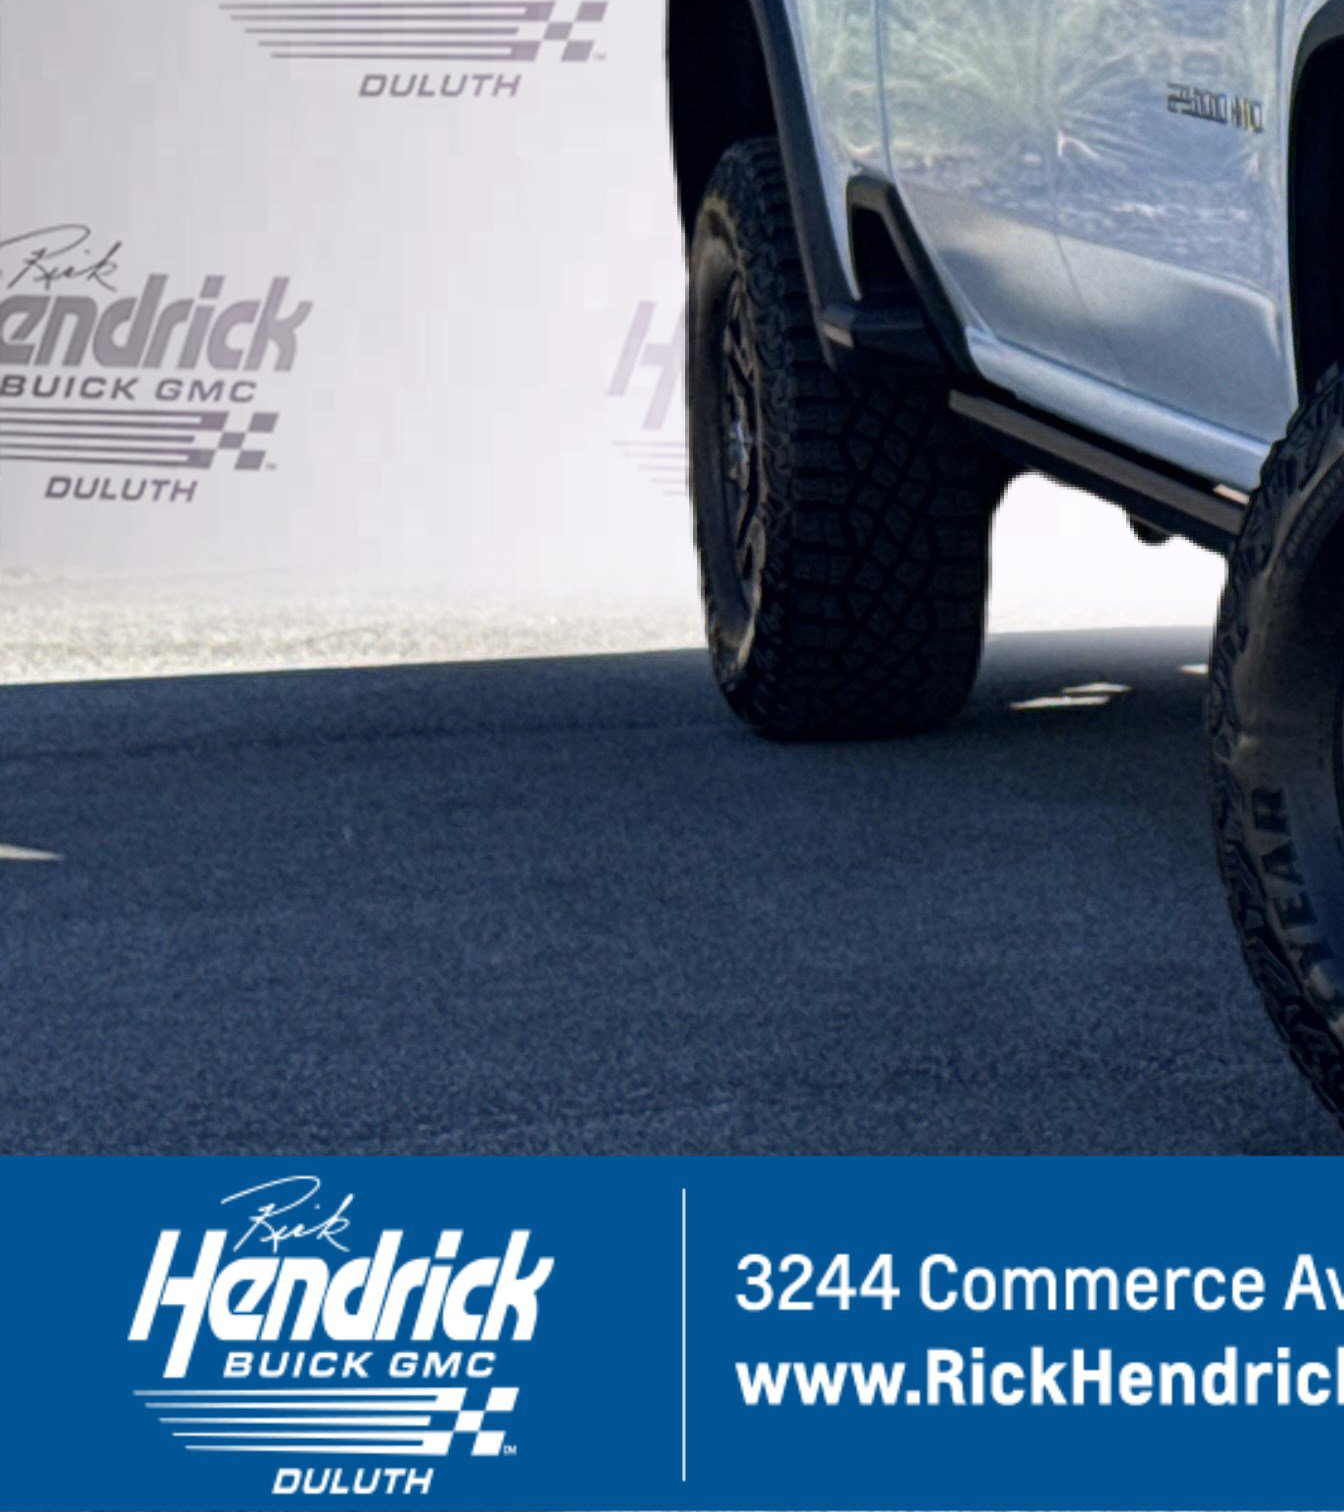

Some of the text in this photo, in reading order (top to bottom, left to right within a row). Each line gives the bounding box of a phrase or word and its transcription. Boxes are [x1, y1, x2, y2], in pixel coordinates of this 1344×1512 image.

[359, 74, 521, 97] DULUTH
[0, 274, 314, 372] endrick
[0, 374, 256, 403] BUICK GMC
[44, 476, 197, 502] DULUTH
